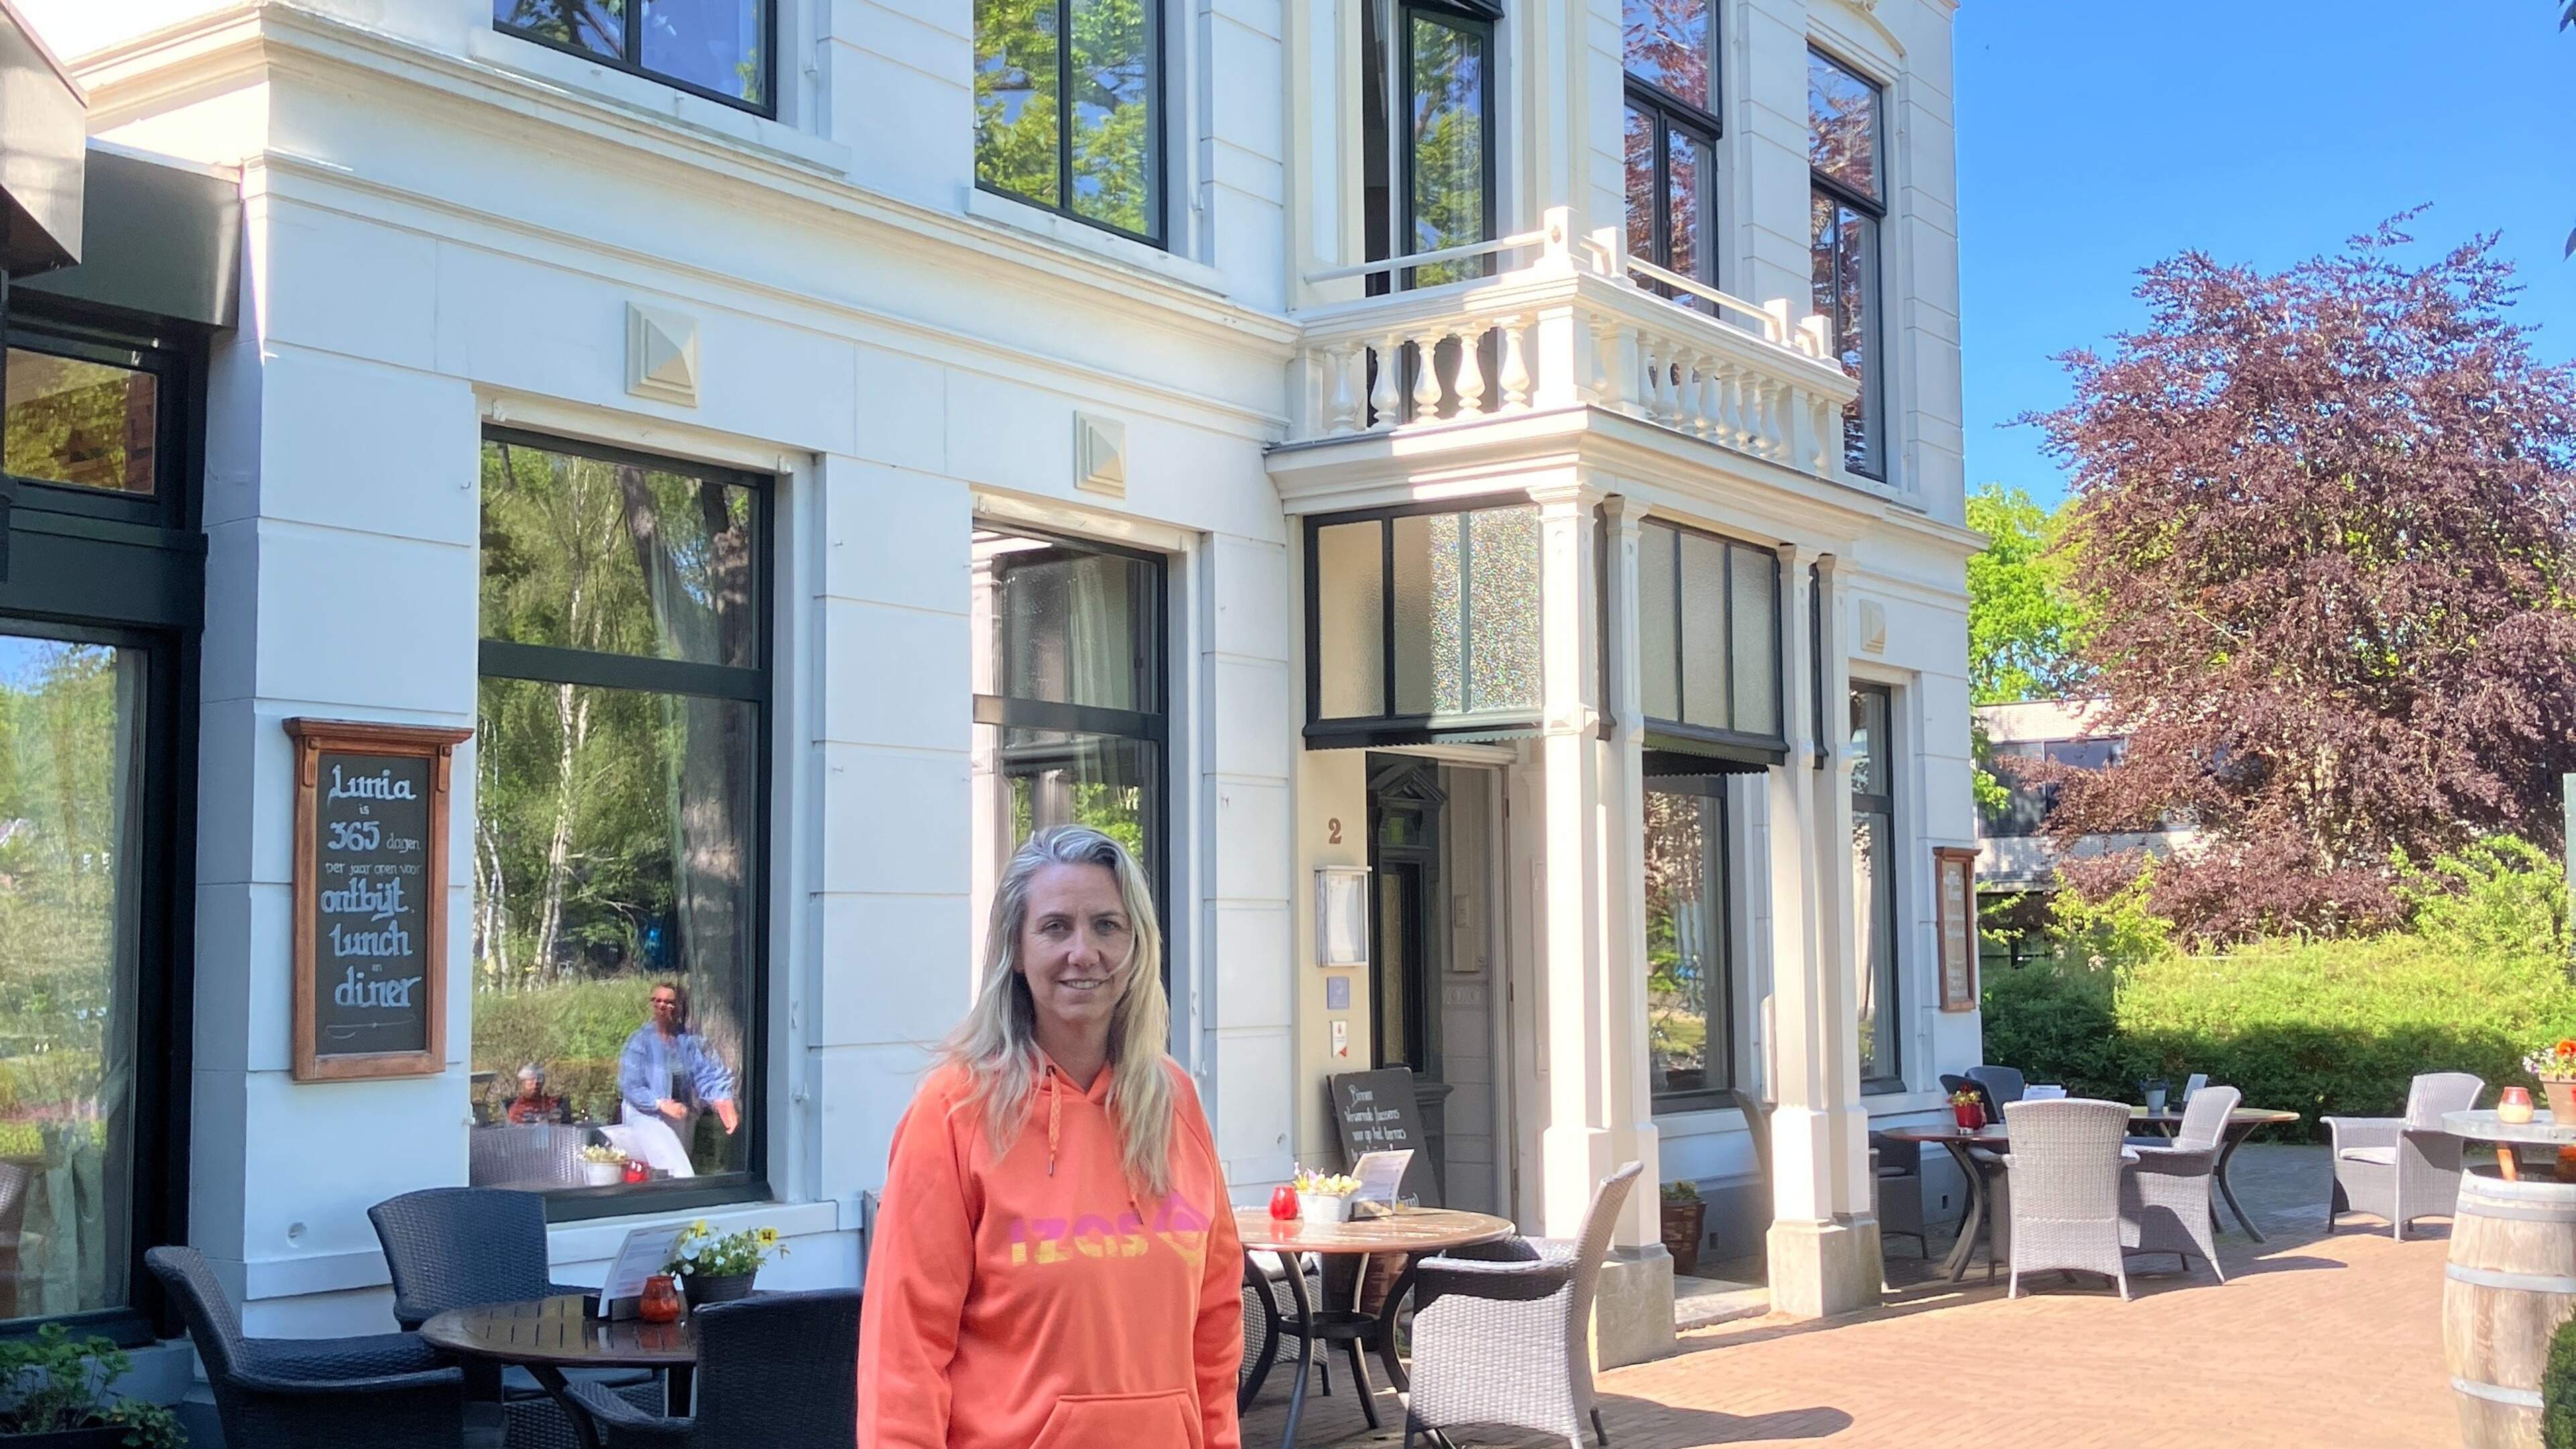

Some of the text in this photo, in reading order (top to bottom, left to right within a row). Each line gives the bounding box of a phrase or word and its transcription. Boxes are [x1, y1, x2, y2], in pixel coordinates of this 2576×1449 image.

[359, 804, 370, 815] is
[327, 820, 420, 853] 365 dagen
[1328, 817, 1342, 845] 2
[349, 863, 371, 875] jaar
[399, 863, 423, 875] voor
[328, 919, 413, 957] lunch
[334, 965, 422, 1008] diner
